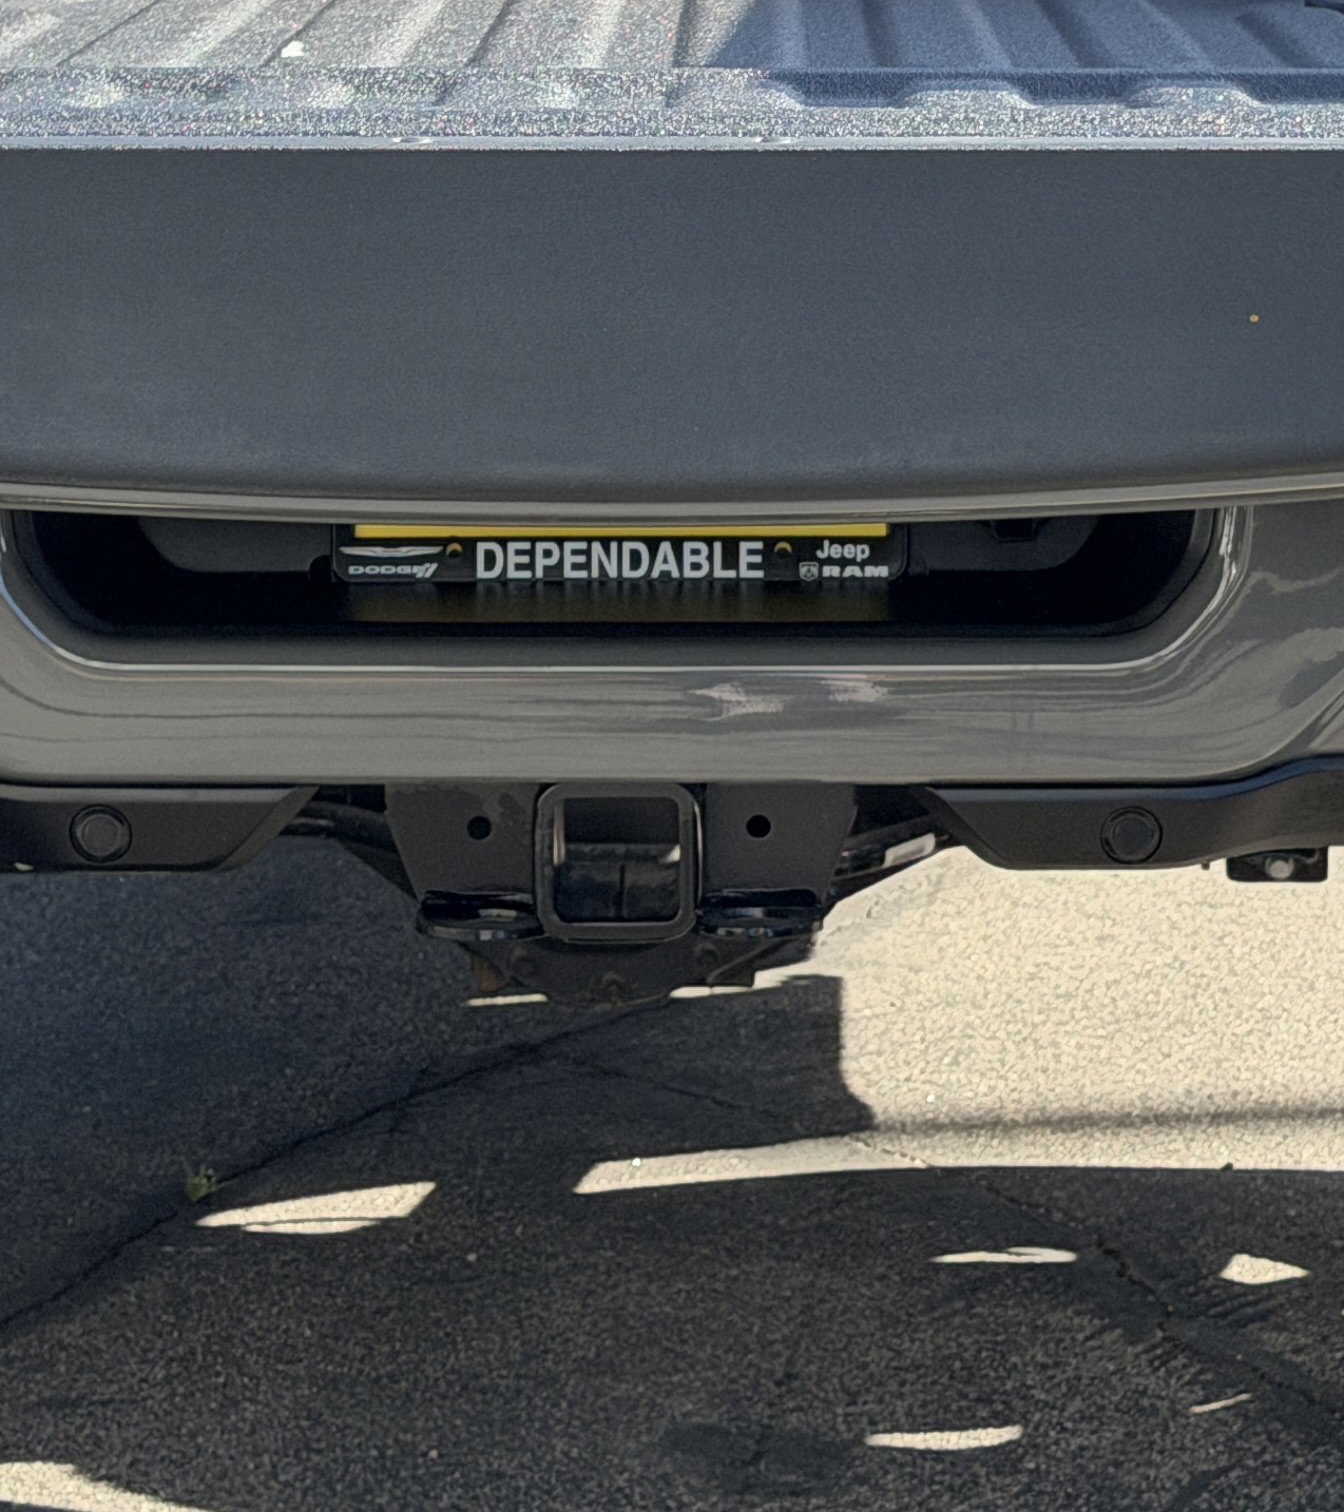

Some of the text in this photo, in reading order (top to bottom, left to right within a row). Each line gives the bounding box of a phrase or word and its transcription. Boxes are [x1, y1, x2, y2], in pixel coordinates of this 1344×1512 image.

[476, 540, 765, 579] DEPENDABLE
[816, 540, 871, 562] Jeep
[822, 565, 889, 577] RAM
